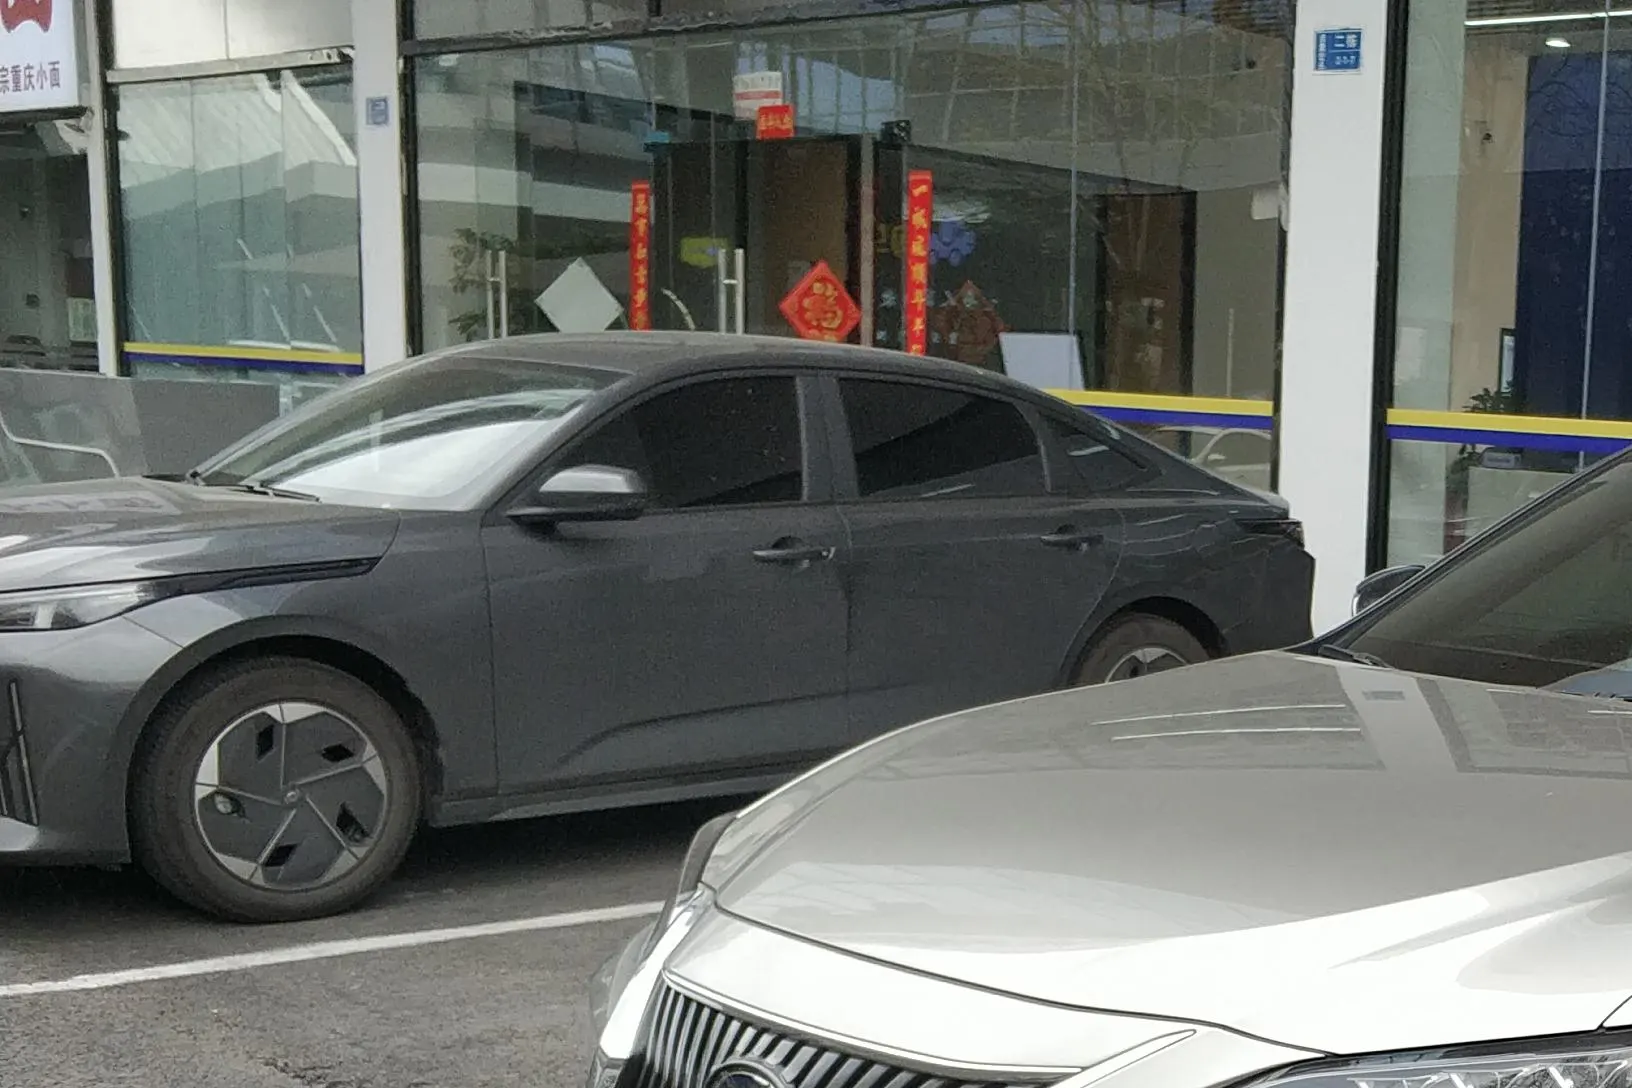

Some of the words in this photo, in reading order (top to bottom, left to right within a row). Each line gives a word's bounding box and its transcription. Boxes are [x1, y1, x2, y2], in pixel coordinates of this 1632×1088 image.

[0, 60, 61, 94] 宗重庆小面
